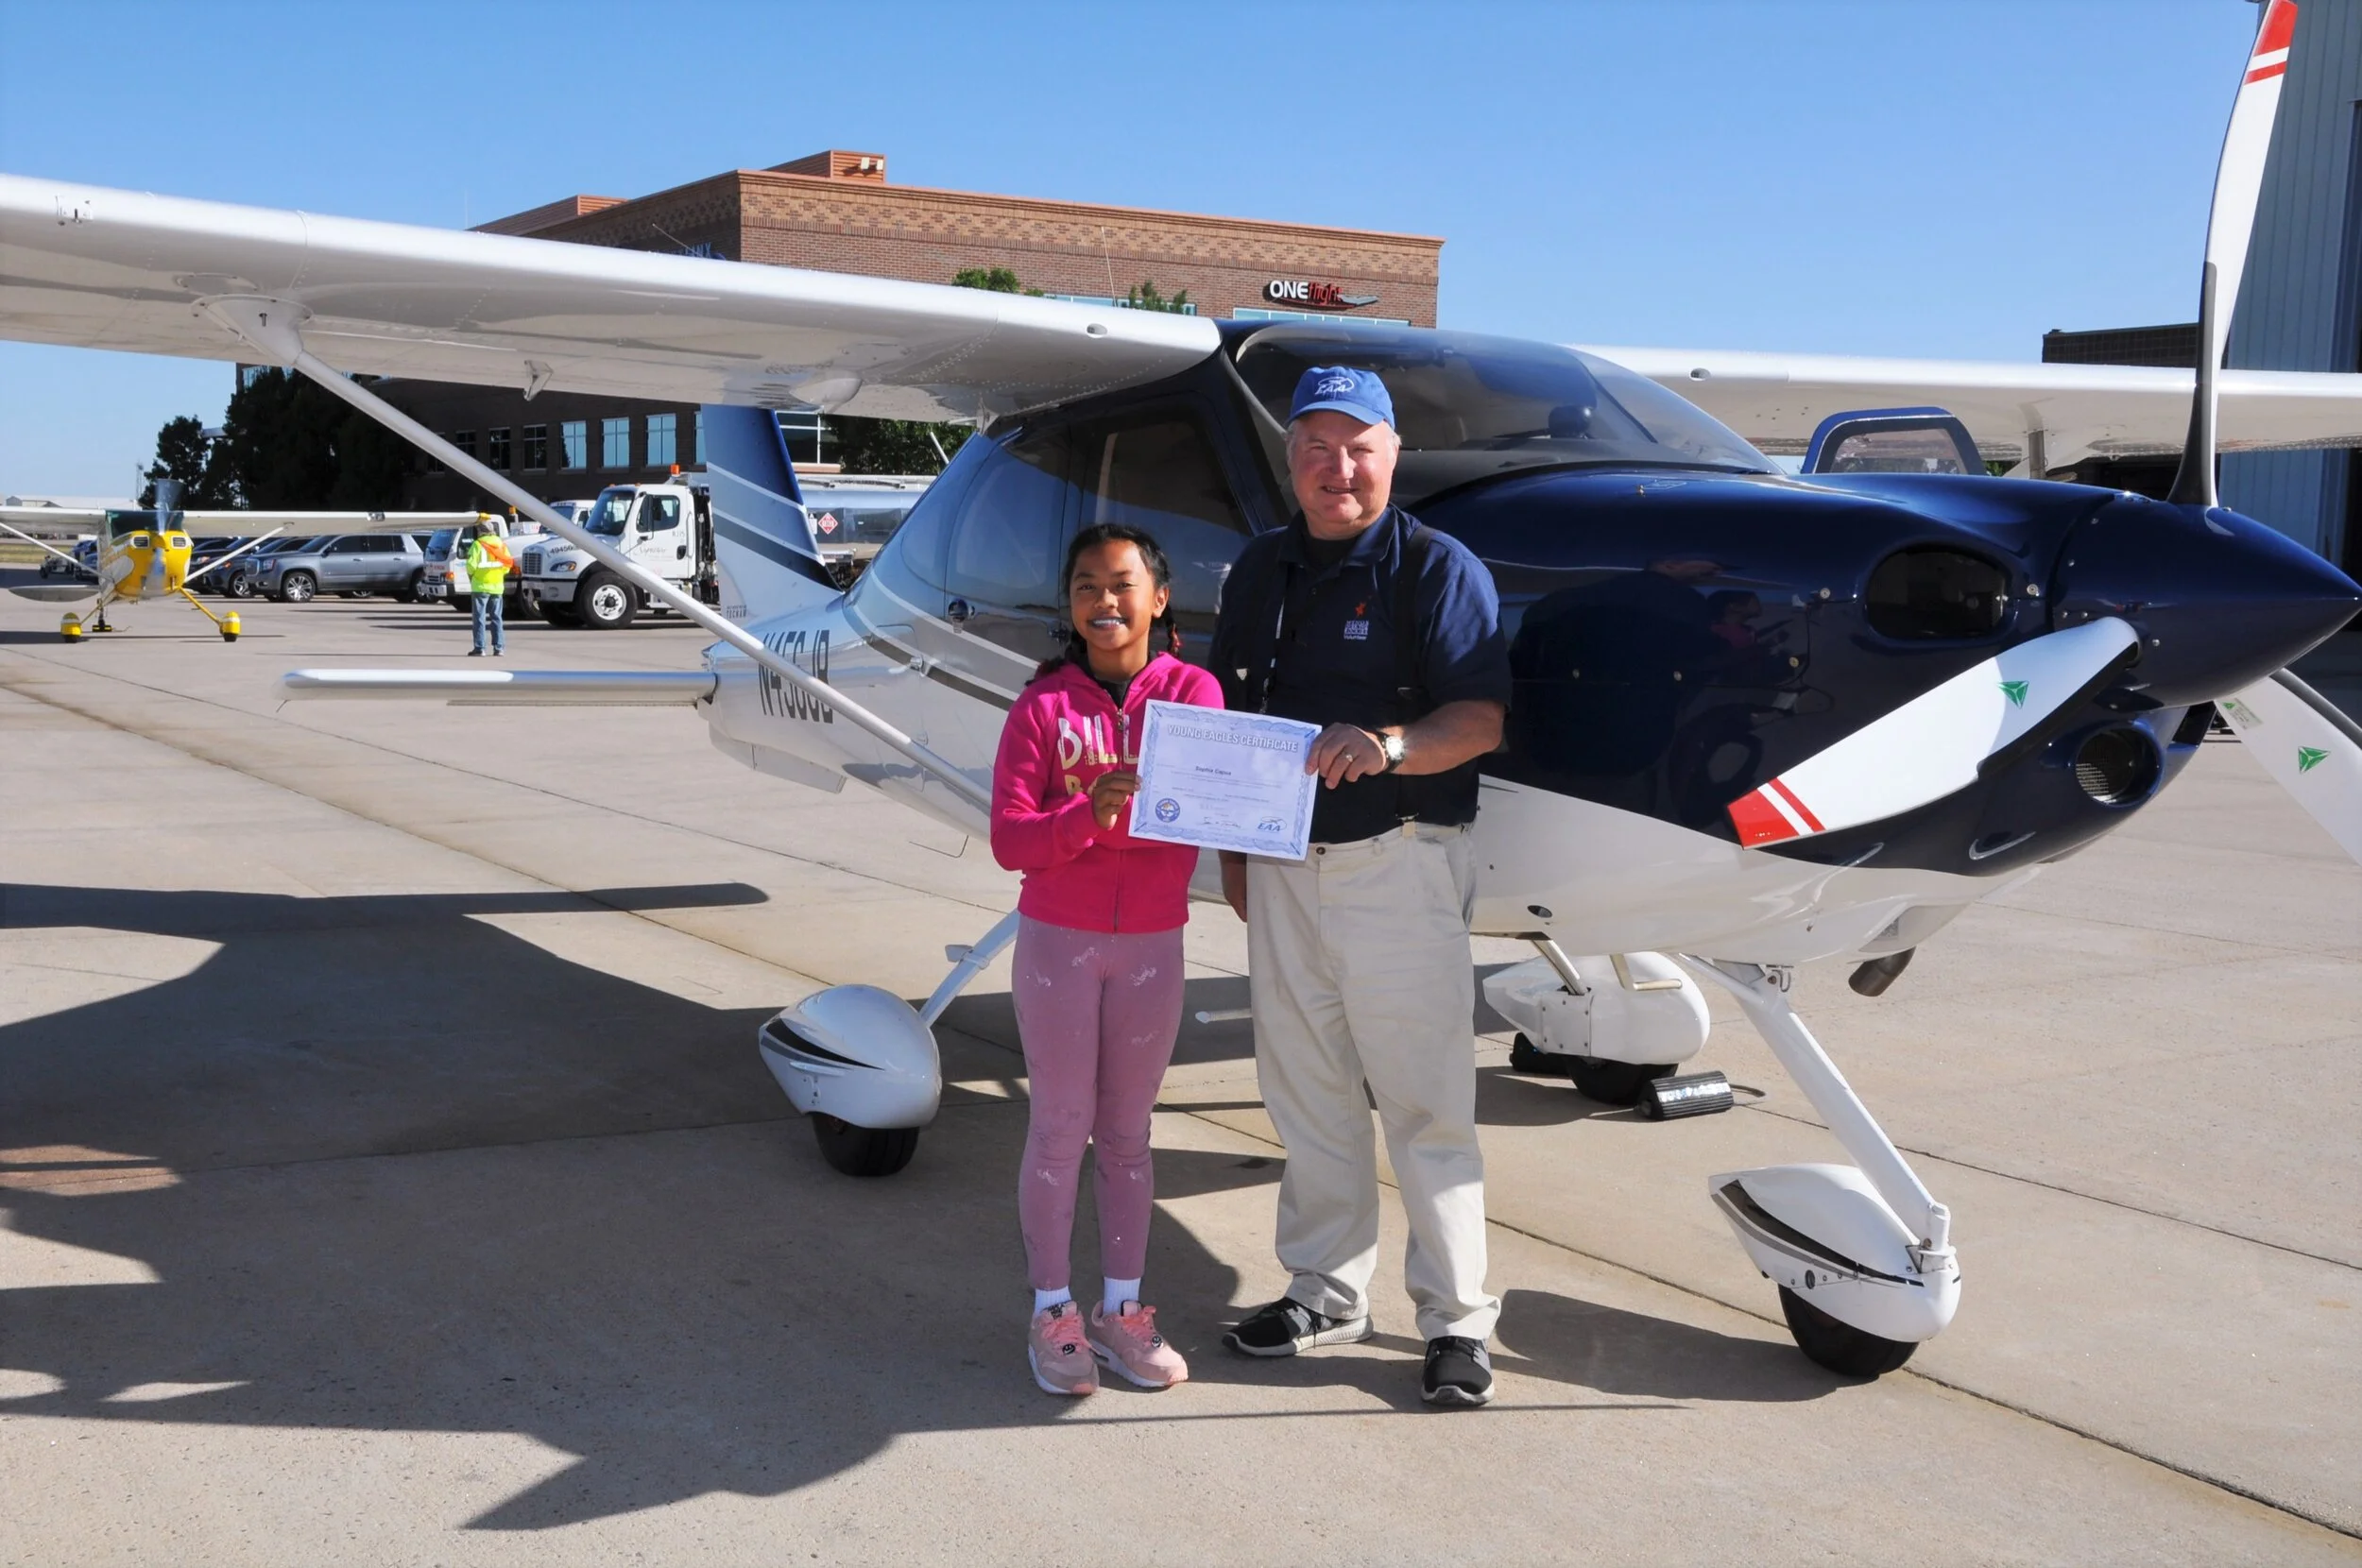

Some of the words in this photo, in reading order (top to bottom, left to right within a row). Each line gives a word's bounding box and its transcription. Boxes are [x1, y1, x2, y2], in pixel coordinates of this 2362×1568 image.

[1315, 383, 1351, 395] EAA
[1168, 724, 1201, 739] YOUNG
[1203, 728, 1239, 745] EAGLES
[1240, 734, 1298, 753] CERTIFICATE
[1258, 822, 1281, 832] EAA
